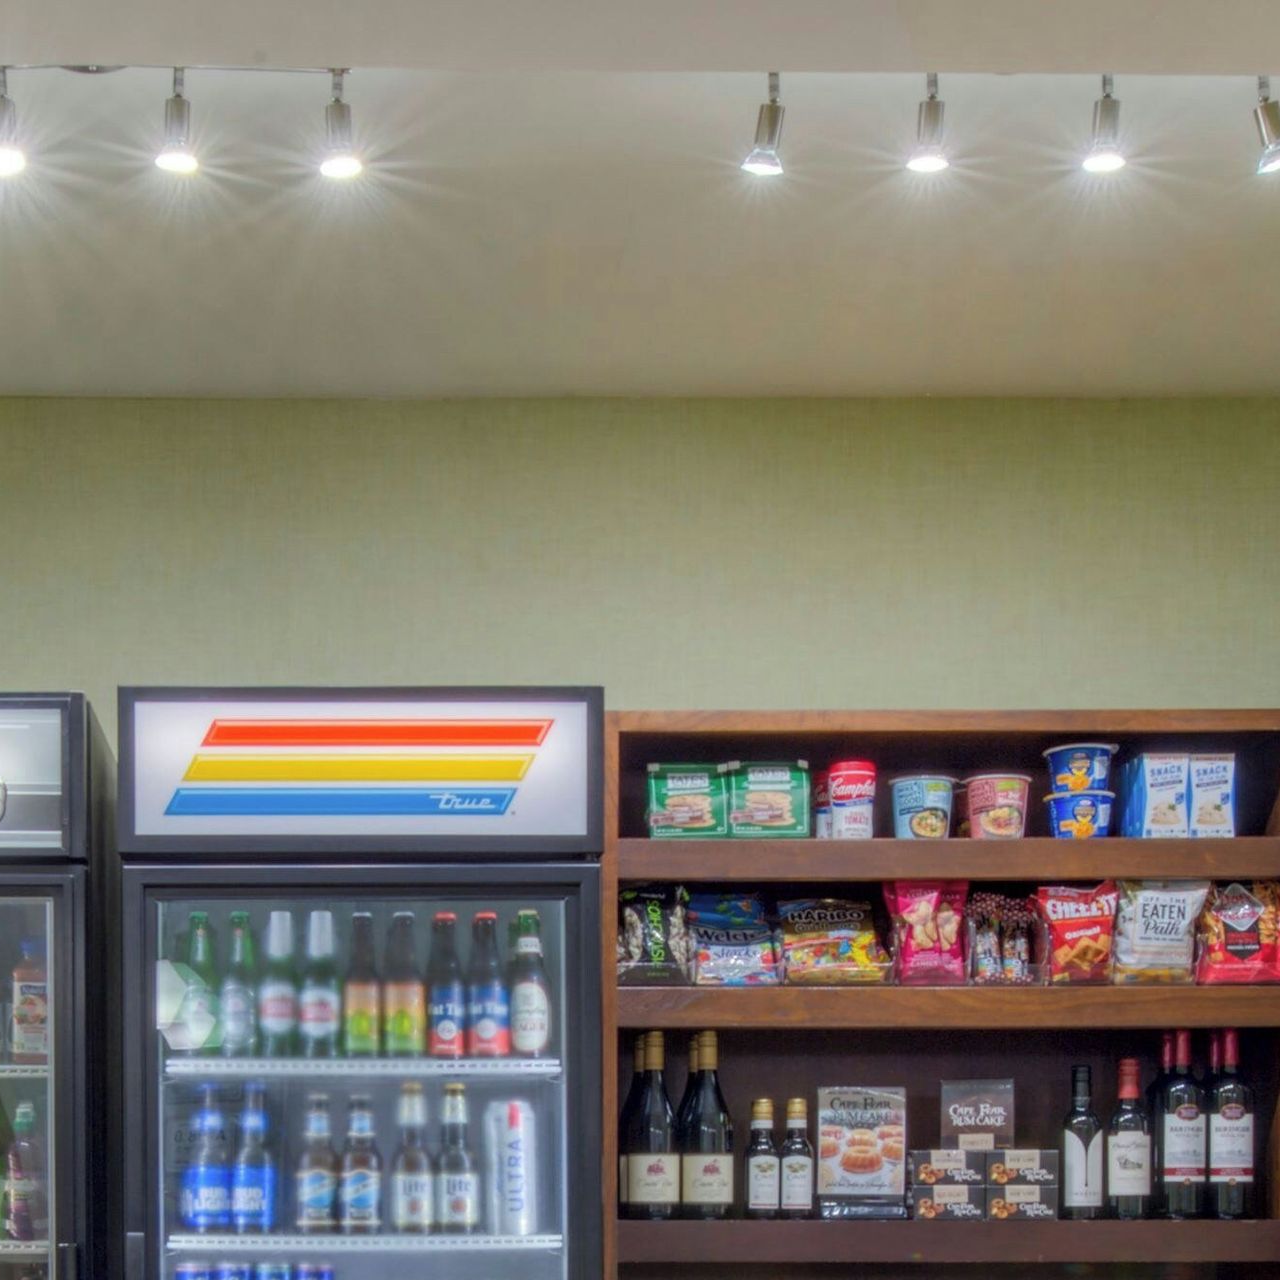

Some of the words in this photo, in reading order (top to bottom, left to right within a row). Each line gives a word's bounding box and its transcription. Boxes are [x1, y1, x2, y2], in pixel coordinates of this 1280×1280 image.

[787, 909, 864, 923] HARIBO
[1141, 903, 1187, 920] EATEN
[1143, 918, 1183, 936] Path
[507, 1139, 525, 1213] ULTRA
[446, 1178, 471, 1196] Lite
